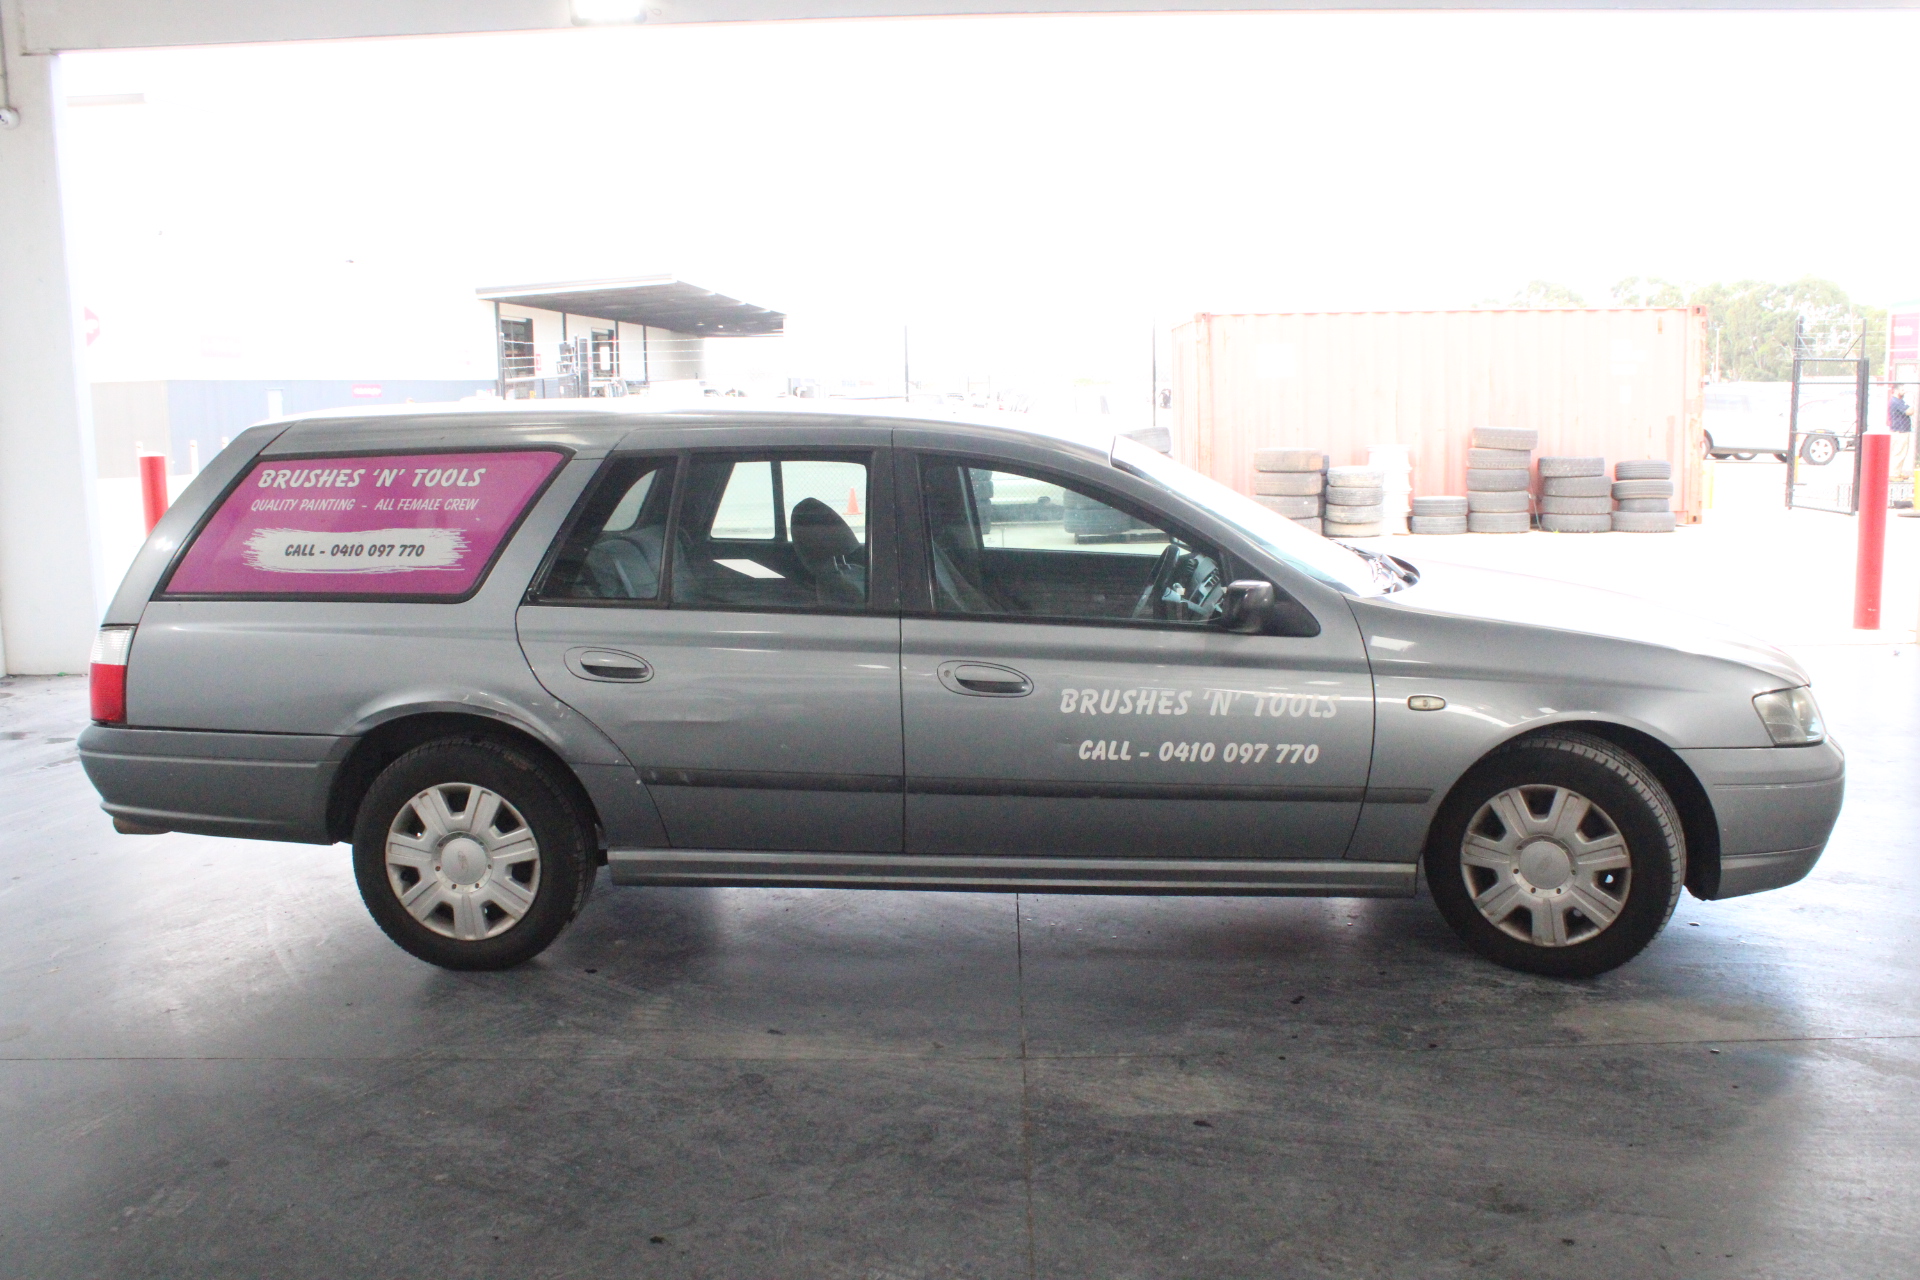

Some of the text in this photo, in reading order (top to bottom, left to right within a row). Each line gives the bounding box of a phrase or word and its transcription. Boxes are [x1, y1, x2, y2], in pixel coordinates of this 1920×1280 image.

[258, 468, 365, 488] BRUSHES
[412, 467, 486, 487] TOOLS
[251, 498, 298, 511] QUALITY
[299, 498, 355, 511] PAINTING
[374, 498, 394, 511] ALL
[396, 498, 440, 510] FEMALE
[441, 498, 479, 511] CREW
[284, 544, 315, 557] CALL
[330, 544, 364, 557] 0410
[367, 544, 395, 557] 097
[399, 544, 425, 557] 770
[1060, 688, 1192, 716] BRUSHES
[1254, 691, 1341, 718] TOOLS
[1078, 740, 1132, 761] CALL
[1158, 741, 1215, 762] 0410
[1222, 743, 1269, 764] 097
[1275, 744, 1319, 764] 770
